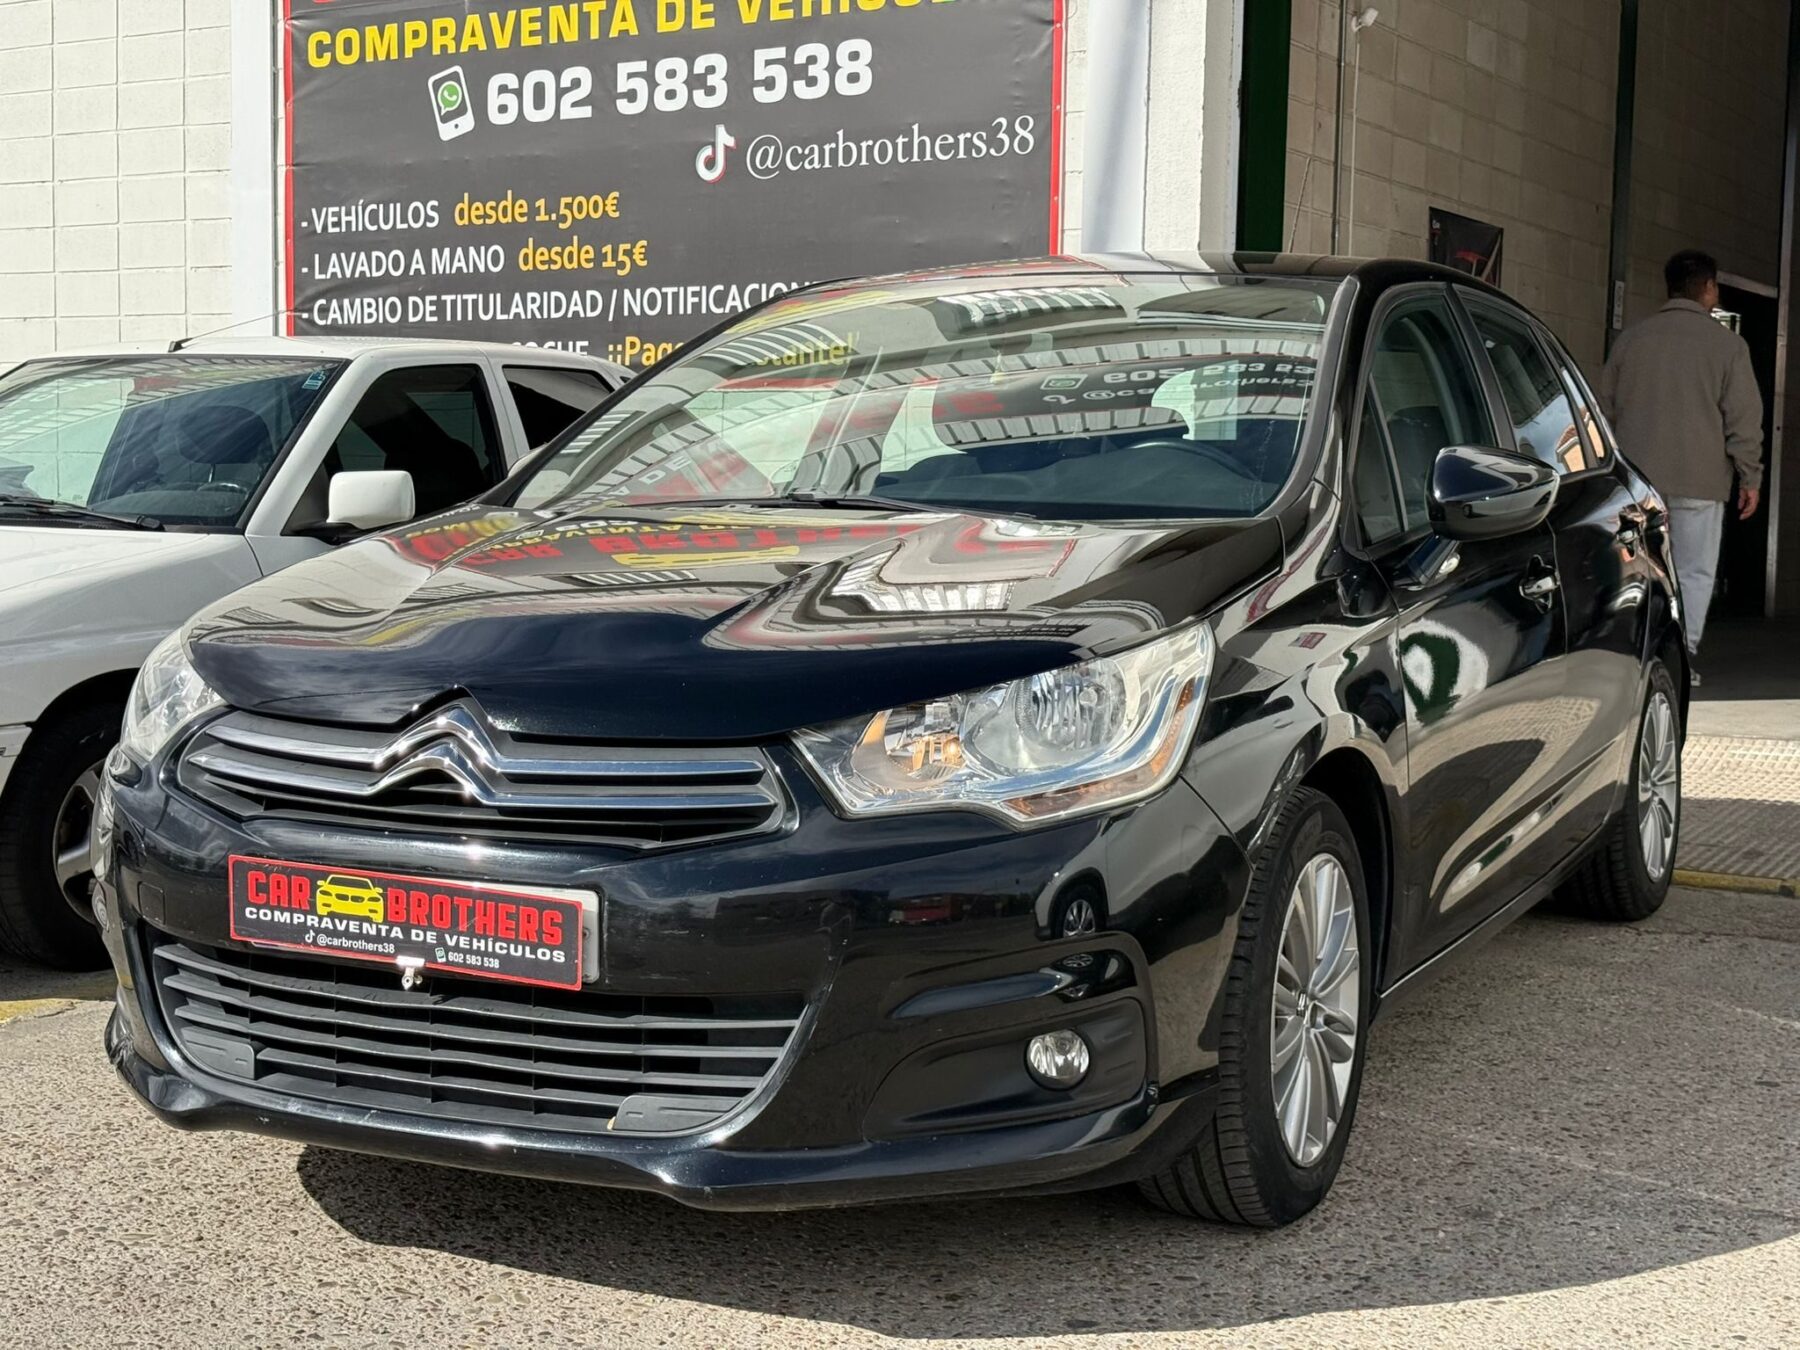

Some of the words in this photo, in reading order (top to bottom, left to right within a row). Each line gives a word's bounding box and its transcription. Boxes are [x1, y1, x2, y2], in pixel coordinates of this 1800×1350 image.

[307, 0, 639, 68] COMPRAVENTA
[656, 0, 715, 33] DE
[487, 66, 593, 125] 602
[615, 57, 728, 115] 583
[752, 38, 873, 104] 538
[745, 115, 1035, 180] @carbrothers38
[312, 199, 440, 233] VEHÍCULOS
[454, 190, 528, 226] desde
[535, 192, 620, 229] 1.500€
[314, 249, 405, 280] LAVADO
[409, 248, 426, 276] A
[431, 244, 505, 274] MANO
[518, 236, 594, 272] desde
[601, 240, 648, 276] 15€
[313, 296, 402, 326] CAMBIO
[408, 295, 438, 322] DE
[442, 289, 603, 322] TITULARIDAD
[244, 907, 404, 939] COMPRAVENTA
[411, 929, 437, 944] DE
[444, 933, 566, 963] VEHÍCULOS
[247, 870, 311, 910] CAR
[387, 887, 563, 946] BROTHERS
[317, 933, 395, 954] @carbrothers38
[448, 952, 464, 963] 602
[466, 954, 482, 966] 583
[483, 957, 500, 969] 538
